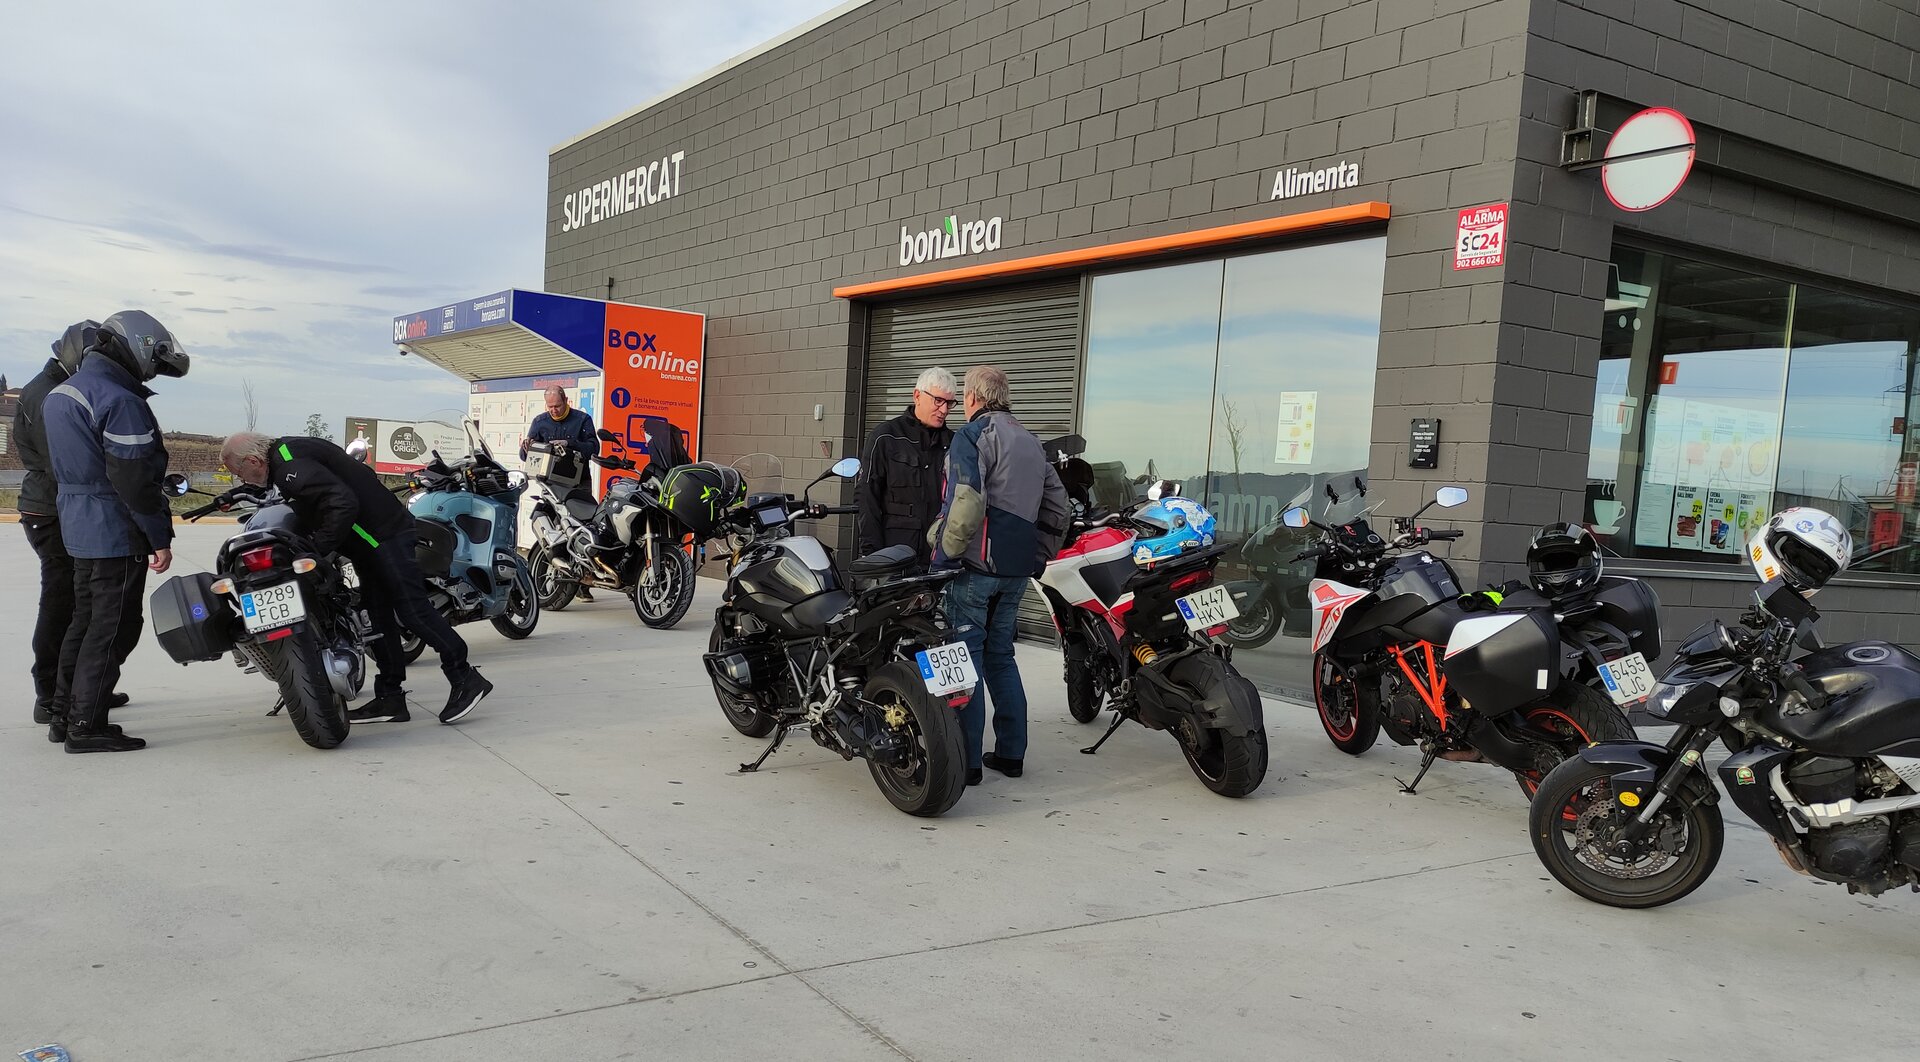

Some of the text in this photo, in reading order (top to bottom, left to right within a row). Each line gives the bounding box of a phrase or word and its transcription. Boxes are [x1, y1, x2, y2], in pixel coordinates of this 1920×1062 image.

[562, 150, 685, 232] SUPERMERCAT
[1270, 160, 1359, 200] Alimenta
[1460, 210, 1505, 227] ALARMA
[1456, 255, 1501, 269] 902 666 024
[394, 316, 427, 341] BOX online
[608, 328, 657, 353] BOX
[628, 351, 699, 374] online
[660, 372, 698, 382] bonarea.com
[616, 390, 624, 406] 1
[638, 403, 669, 411] bonarea.com
[659, 399, 677, 407] compra
[1195, 492, 1279, 545] amp
[254, 585, 295, 607] 3289
[1190, 588, 1224, 611] 1447
[258, 603, 290, 624] FCB
[1196, 605, 1225, 625] HKV
[930, 646, 969, 669] 9509
[1609, 655, 1646, 680] 5455
[939, 666, 965, 687] JKD
